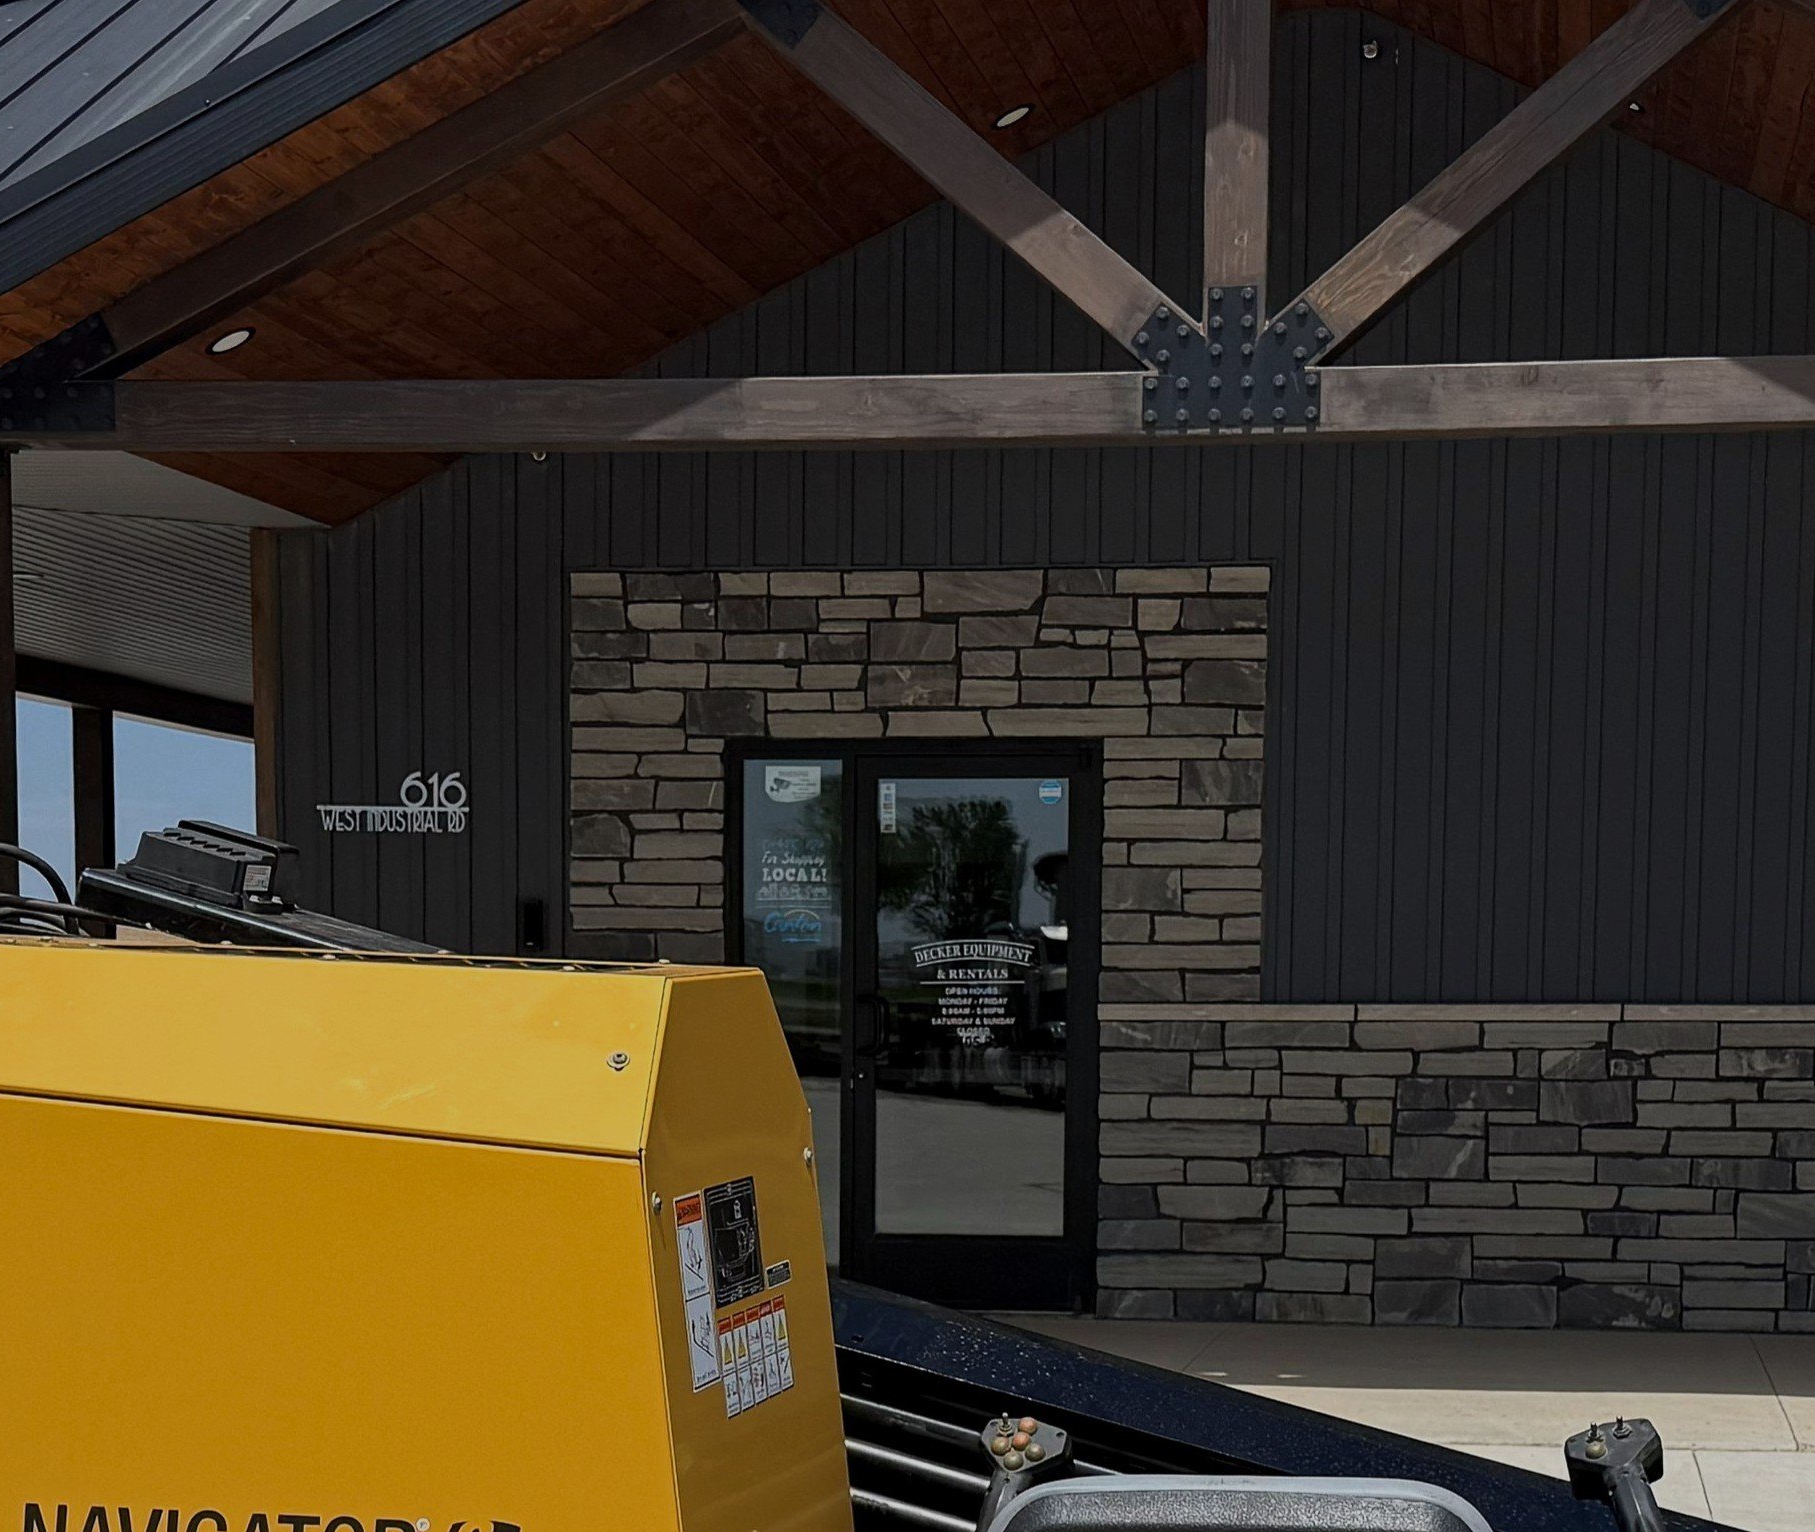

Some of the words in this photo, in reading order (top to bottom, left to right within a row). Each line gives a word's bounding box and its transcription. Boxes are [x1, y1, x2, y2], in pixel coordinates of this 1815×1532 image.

[400, 771, 467, 807] 616
[321, 810, 361, 832] WEST
[366, 810, 443, 833] INDUSTRIAL
[447, 811, 466, 833] RD
[762, 868, 827, 883] LOCAL!
[914, 944, 961, 963] DECKER
[963, 944, 1033, 962] EQUIPMENT
[936, 969, 947, 980] &
[949, 969, 1009, 980] RENTALS
